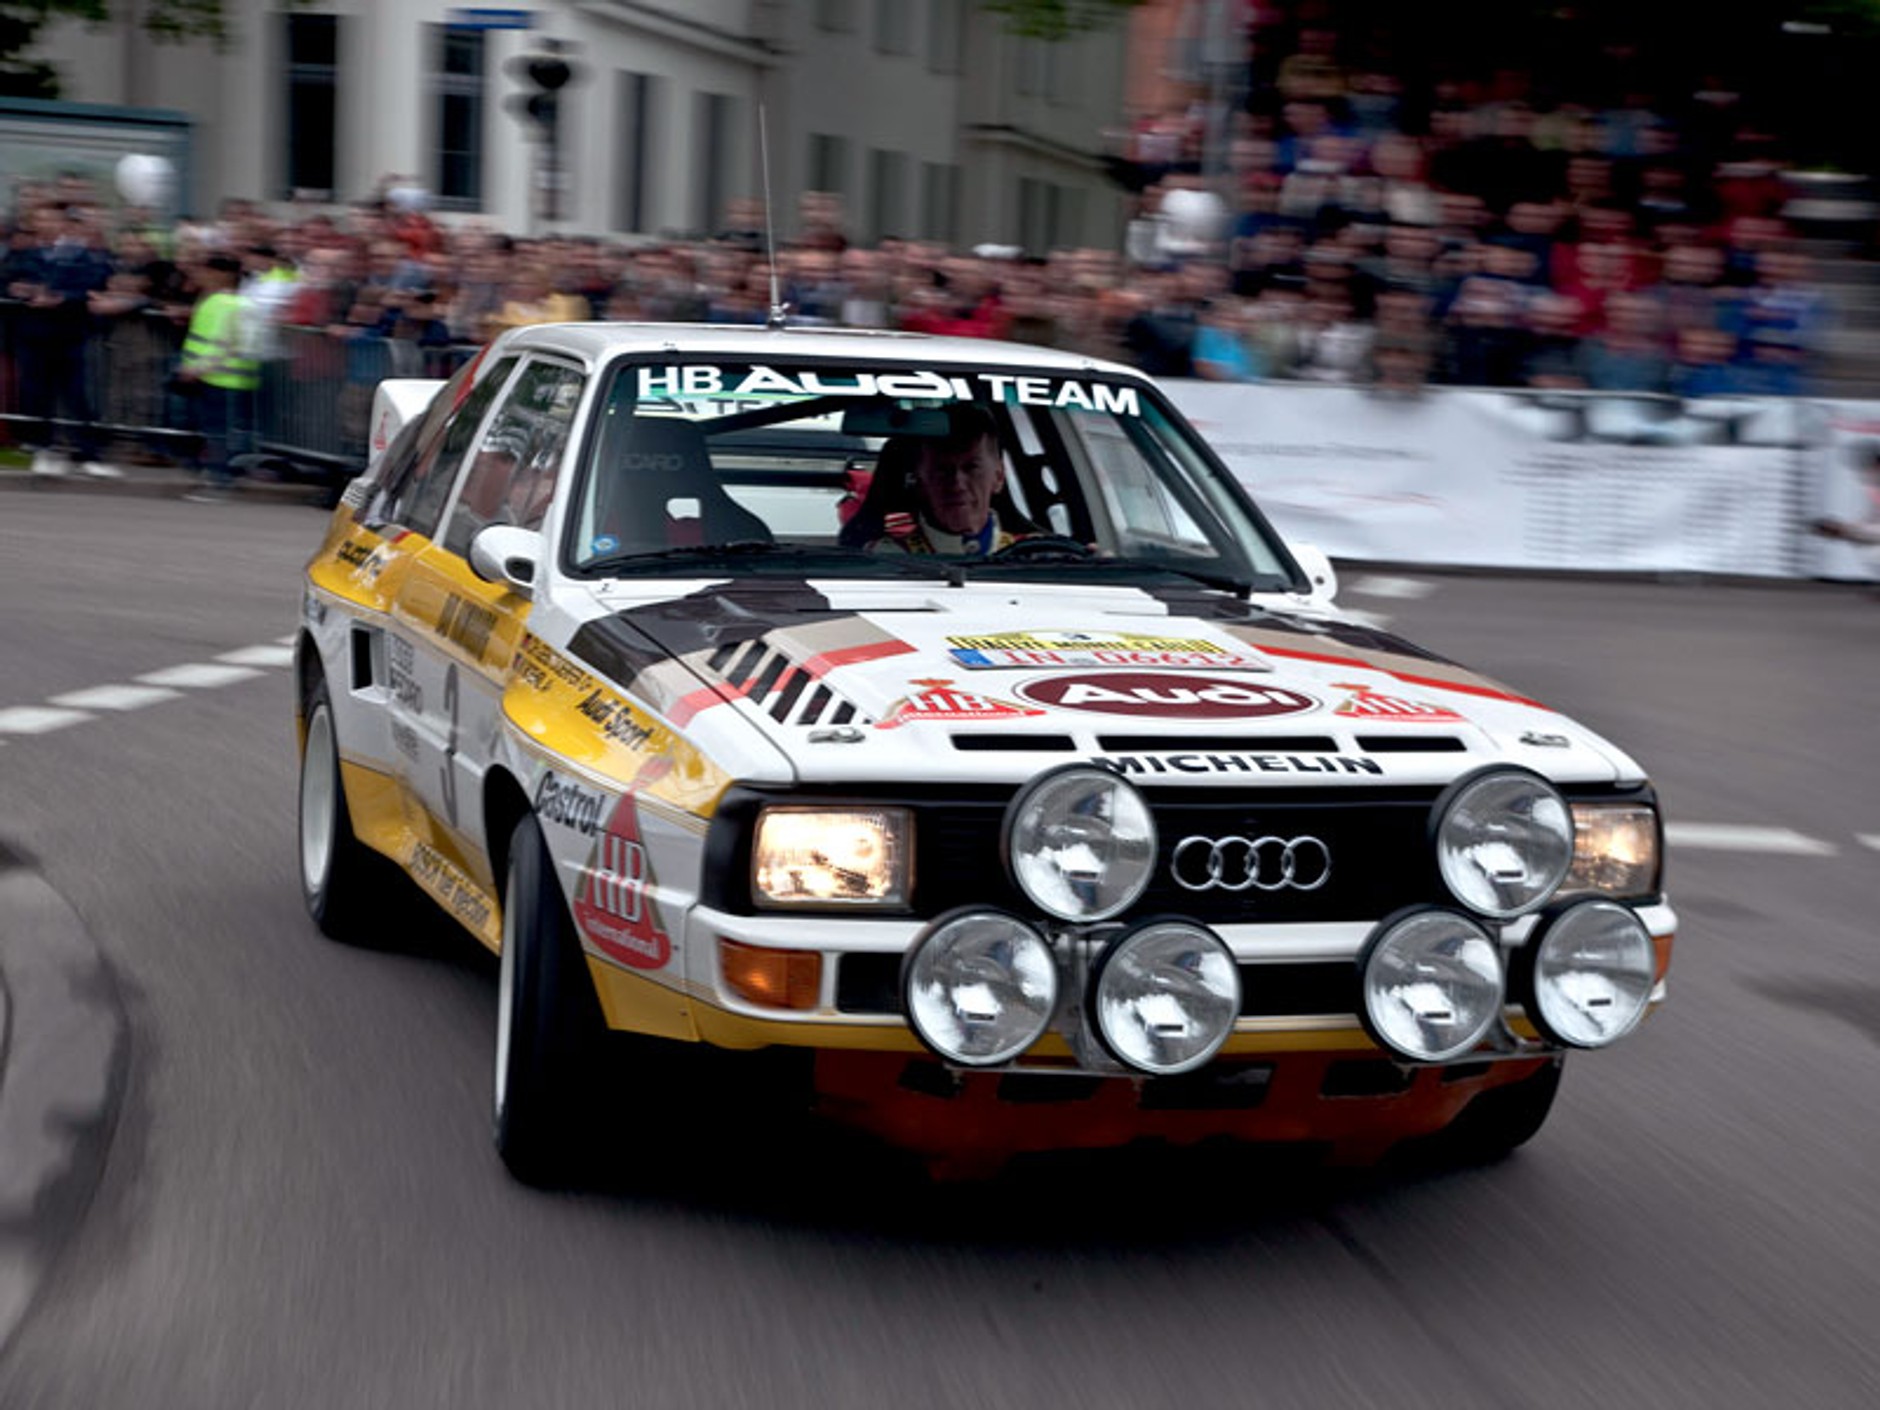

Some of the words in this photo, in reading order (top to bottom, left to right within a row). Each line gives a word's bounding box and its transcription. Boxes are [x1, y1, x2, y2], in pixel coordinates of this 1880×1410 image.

[637, 365, 723, 396] HB
[977, 373, 1141, 417] TEAM
[575, 688, 620, 724] Audi
[603, 706, 654, 751] Sport
[908, 694, 994, 711] HB
[1090, 754, 1384, 776] MICHELIN
[536, 769, 607, 838] Castrol
[593, 827, 649, 924] HB
